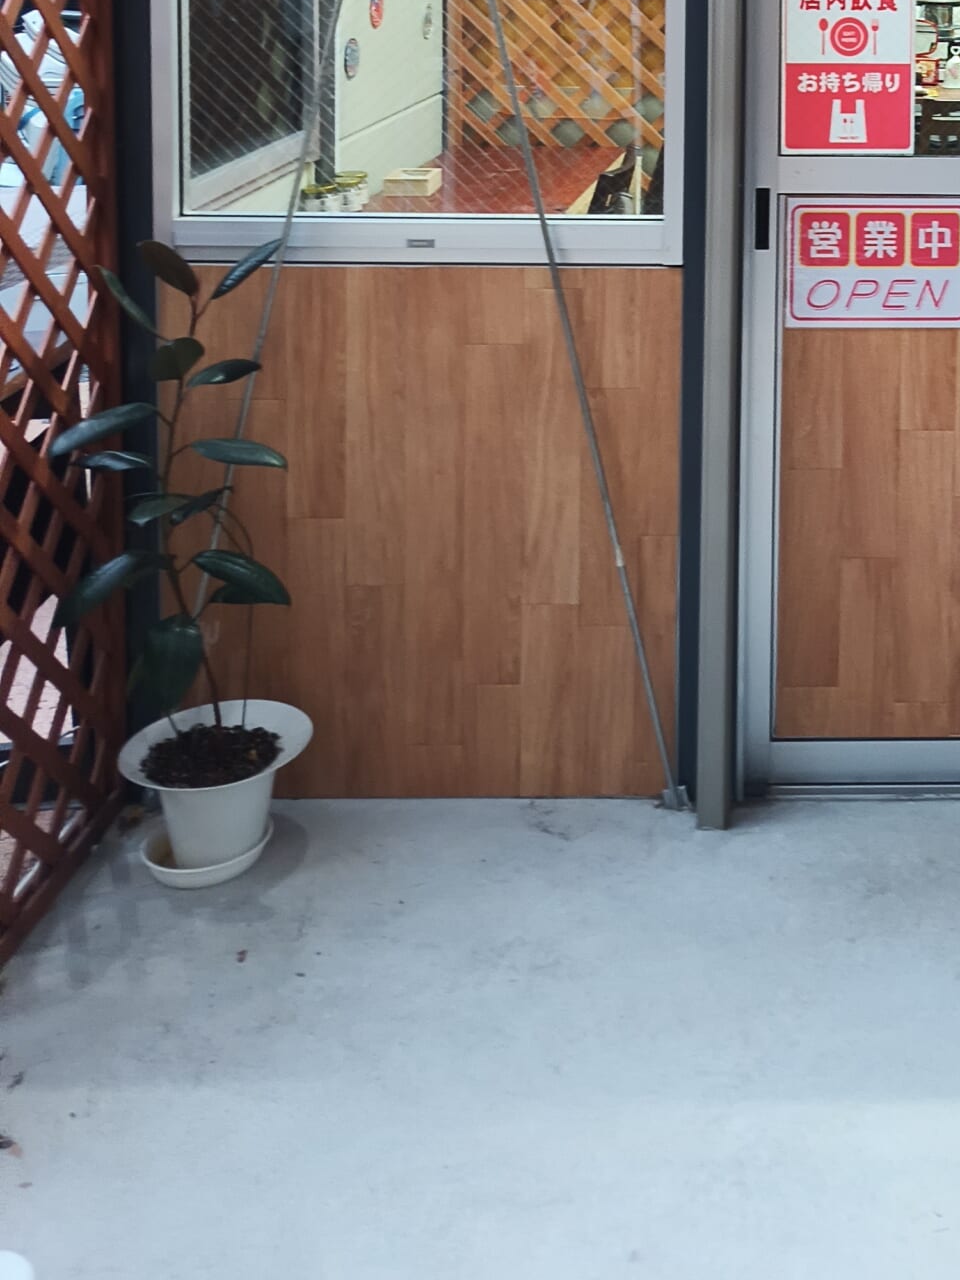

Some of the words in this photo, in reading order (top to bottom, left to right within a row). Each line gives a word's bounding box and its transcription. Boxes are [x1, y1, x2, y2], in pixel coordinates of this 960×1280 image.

[796, 71, 901, 94] お持ち帰り
[807, 220, 953, 261] 営業中
[805, 279, 951, 311] OPEN
